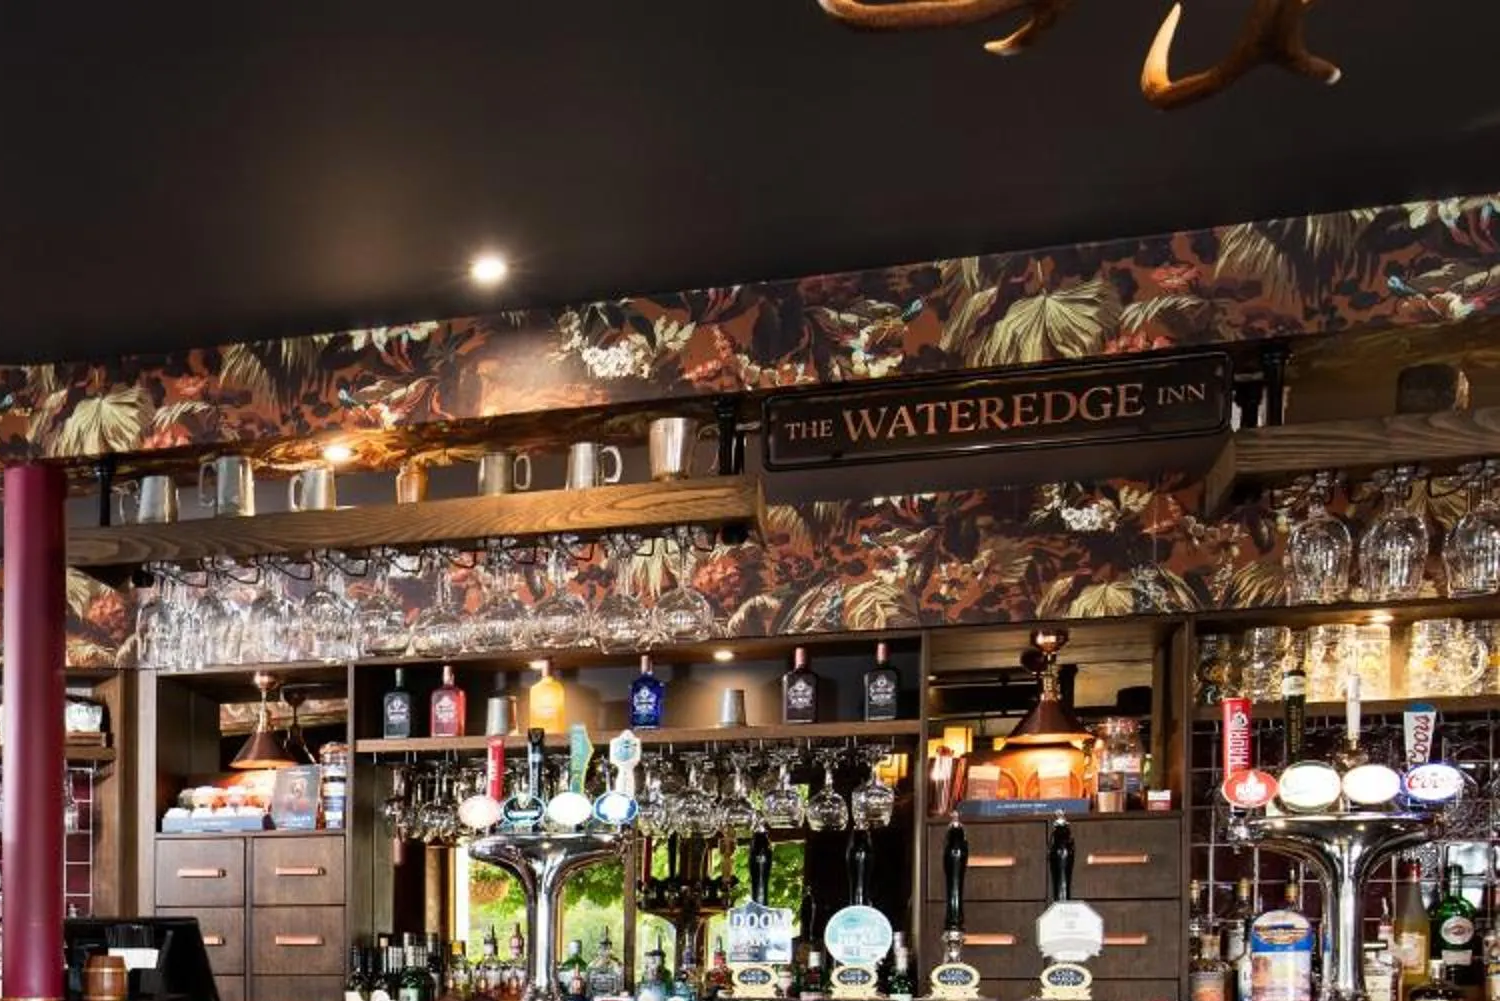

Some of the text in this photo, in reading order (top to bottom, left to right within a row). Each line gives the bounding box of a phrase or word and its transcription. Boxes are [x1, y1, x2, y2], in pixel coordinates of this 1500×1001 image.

[784, 382, 1206, 442] THE WATEREDGE INN
[1408, 714, 1431, 765] Coors
[732, 912, 792, 929] DOOM
